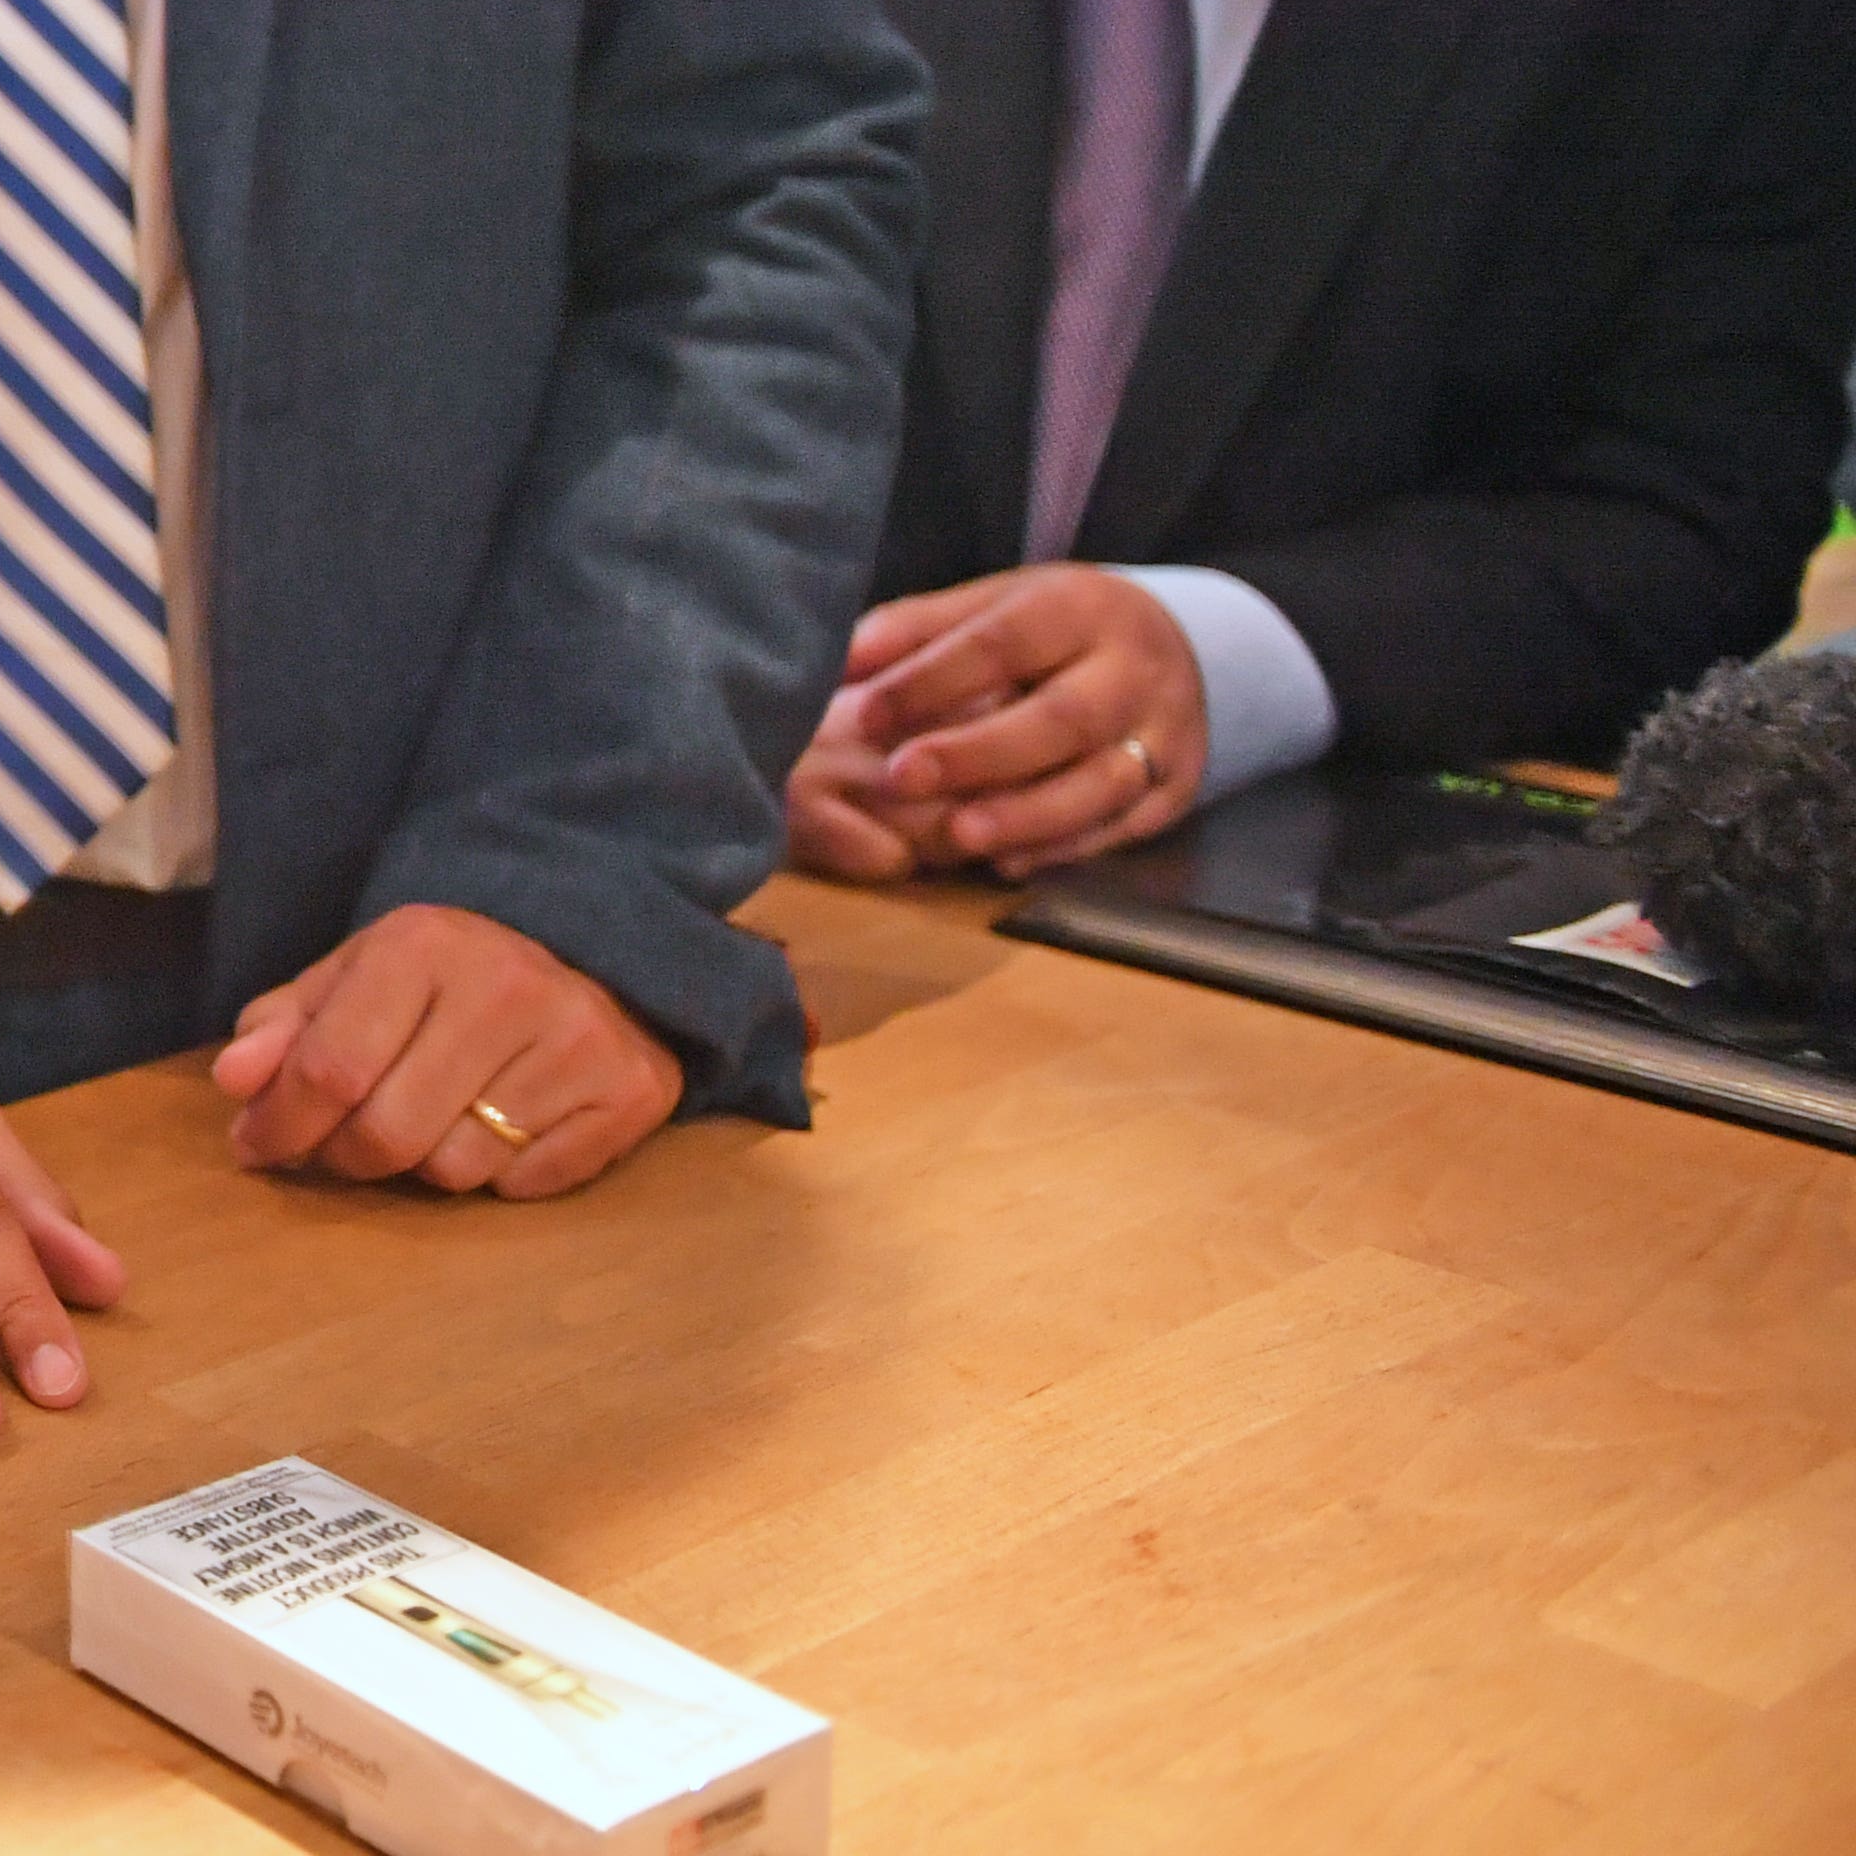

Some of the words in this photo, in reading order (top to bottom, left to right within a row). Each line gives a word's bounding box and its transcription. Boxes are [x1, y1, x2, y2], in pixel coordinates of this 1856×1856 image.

[168, 1490, 297, 1543] SUBSTANCE
[204, 1506, 317, 1555] ADDICTIVE
[308, 1508, 387, 1540] WHICH
[264, 1542, 290, 1555] A
[285, 1532, 317, 1549] IS
[311, 1521, 420, 1565] CONTAINS
[368, 1545, 426, 1569] THIS
[194, 1549, 274, 1587] HIGHLY
[217, 1557, 319, 1606] NICOTINE
[272, 1562, 376, 1609] PRODUCT
